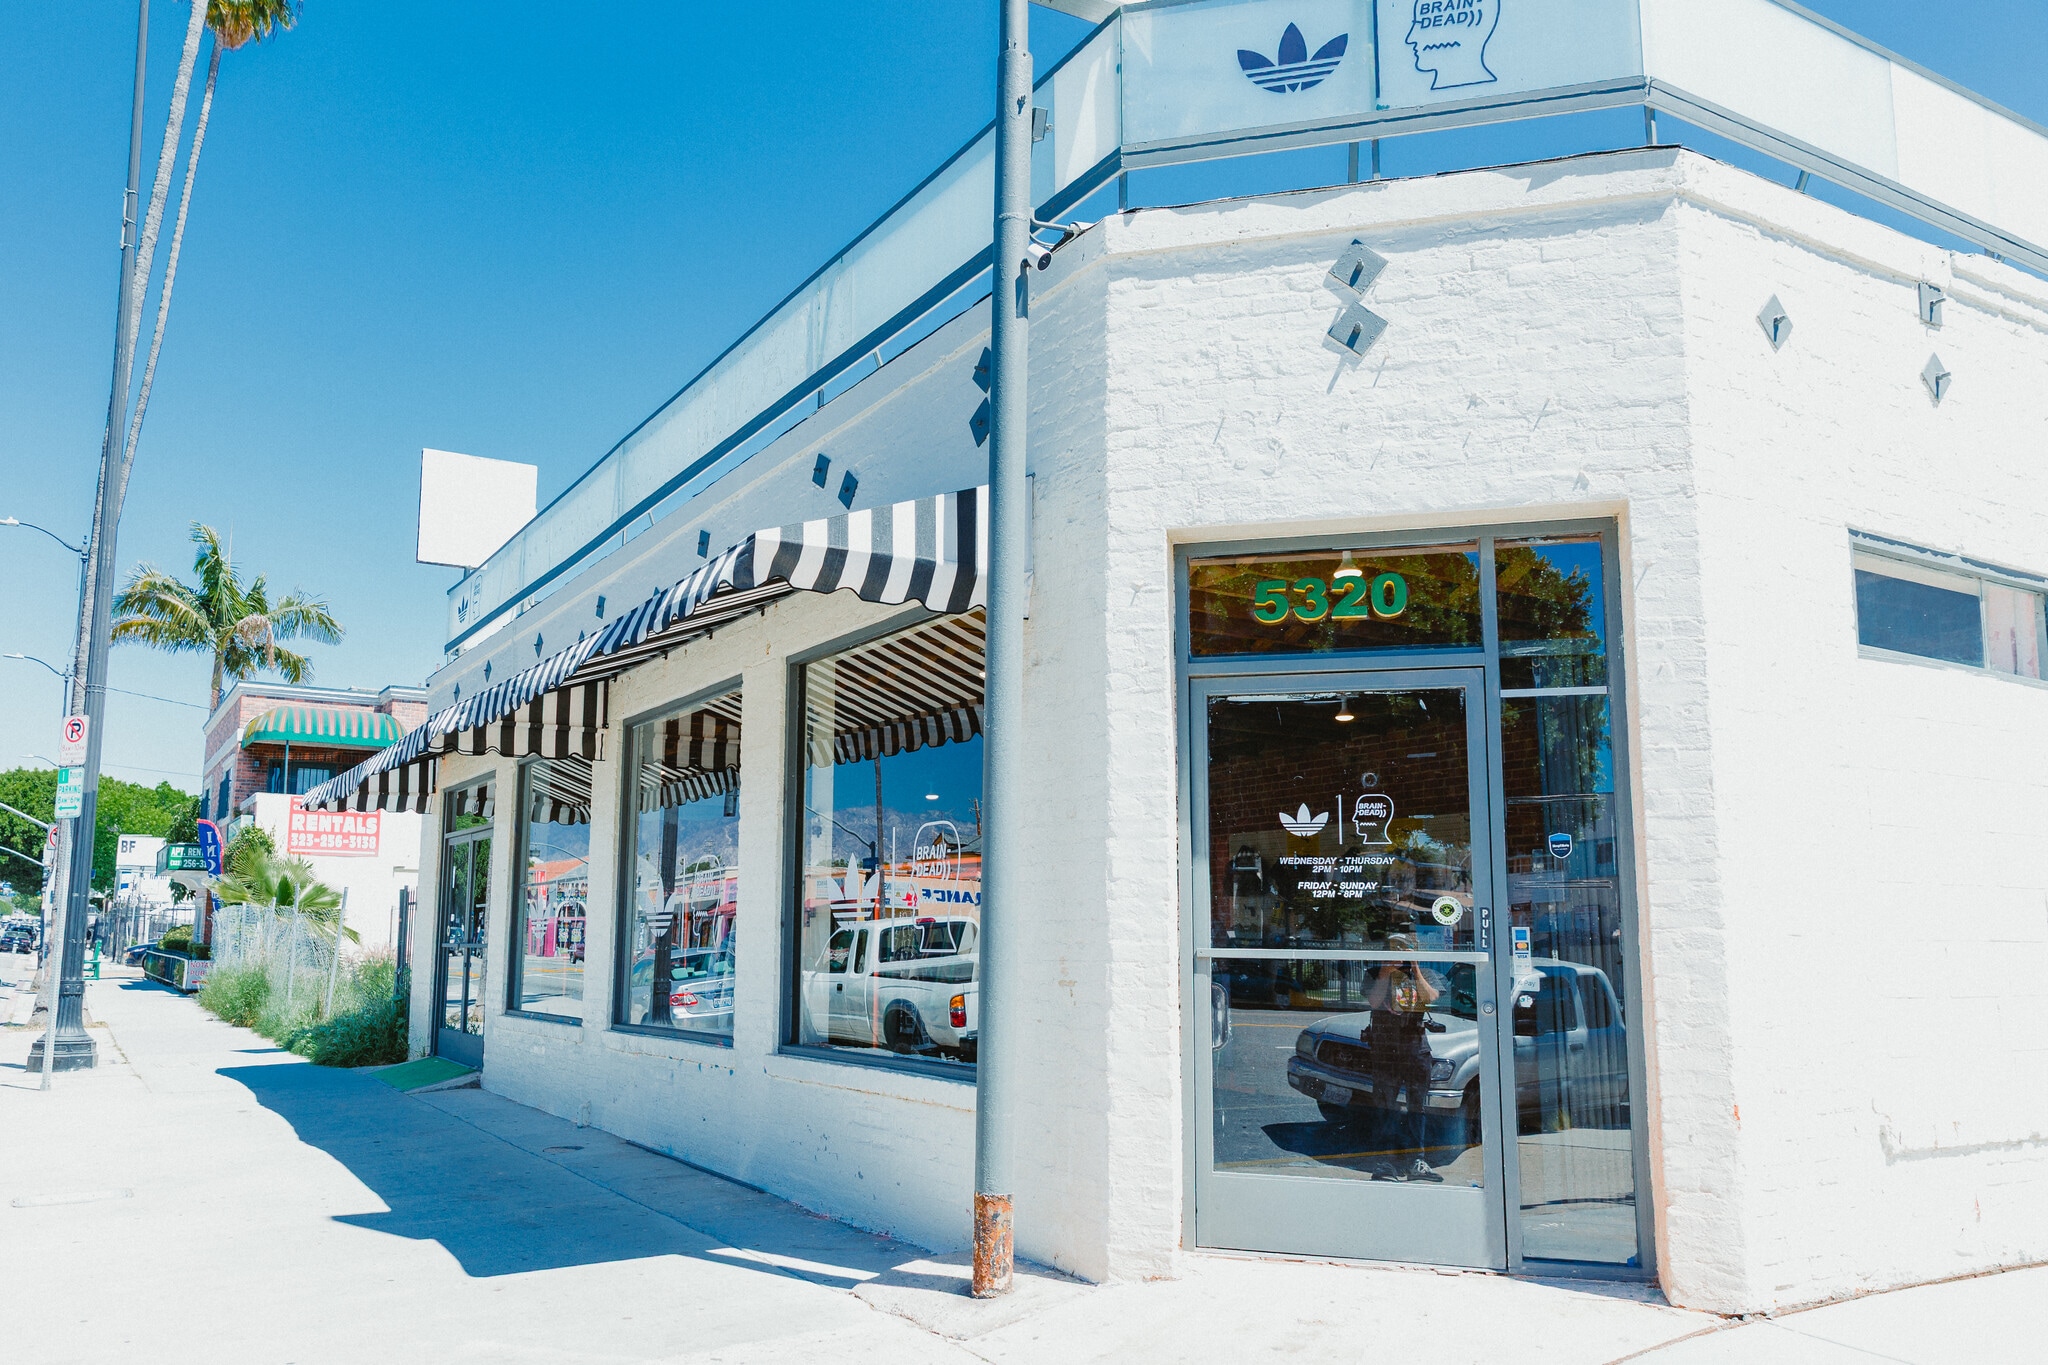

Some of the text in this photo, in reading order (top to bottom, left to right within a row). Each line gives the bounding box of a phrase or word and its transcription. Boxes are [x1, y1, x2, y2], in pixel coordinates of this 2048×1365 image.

[1420, 0, 1483, 15] BRAIN-
[1253, 572, 1408, 624] 5320
[58, 785, 82, 795] PARKING
[291, 813, 378, 834] RENTALS
[290, 832, 377, 849] 323-256-3138
[121, 840, 136, 853] BF
[1279, 857, 1337, 865] WEDNESDAY
[1345, 857, 1395, 865] THURSDAY
[1312, 865, 1332, 873] 2PM
[1340, 865, 1363, 873] 10PM
[1297, 882, 1332, 890] FRIDAY
[1339, 882, 1378, 890] SUNDAY
[1312, 890, 1336, 898] 12PM
[1343, 890, 1363, 898] 8PM
